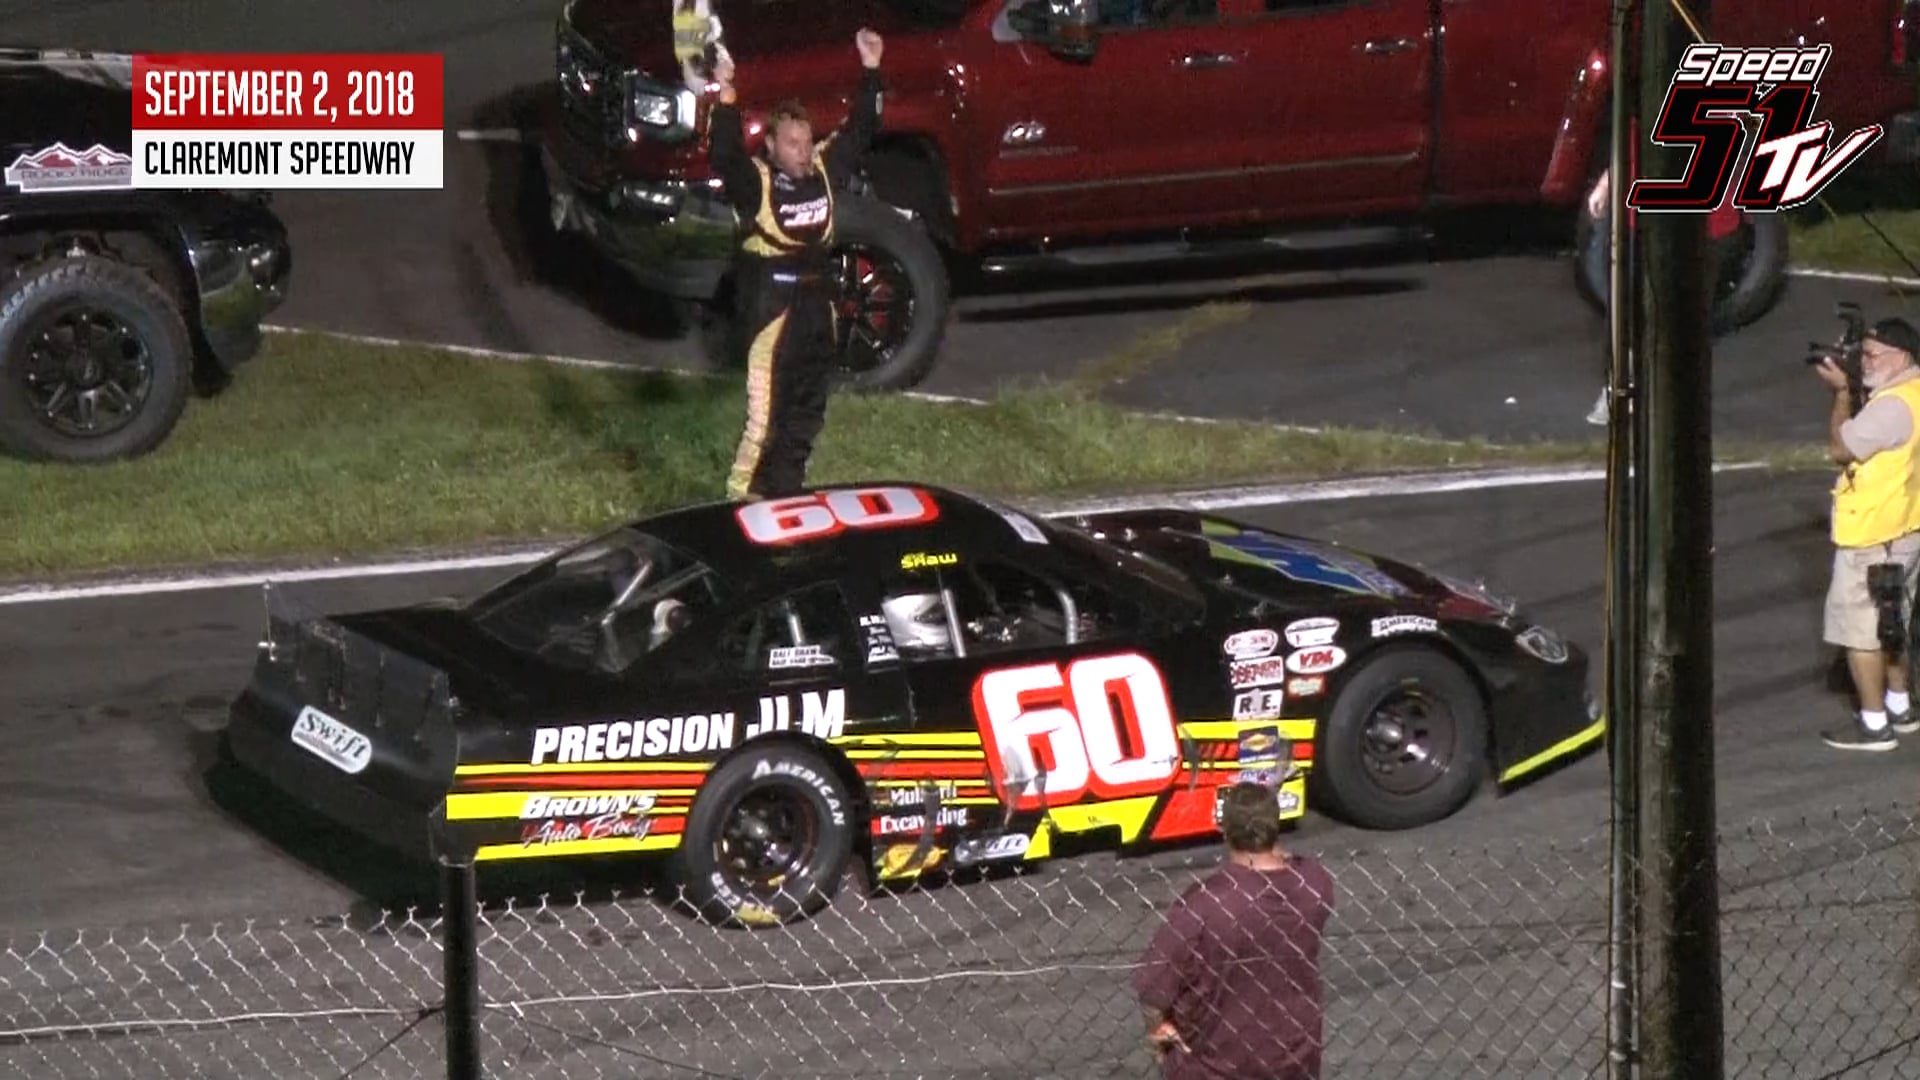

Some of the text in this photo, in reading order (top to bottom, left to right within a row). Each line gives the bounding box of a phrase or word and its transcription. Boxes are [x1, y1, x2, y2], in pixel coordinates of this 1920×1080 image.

[735, 485, 939, 546] 60
[300, 713, 367, 759] Swift
[530, 713, 735, 765] PRECISION
[971, 654, 1182, 811] 60
[519, 792, 657, 819] BROWN'S
[752, 759, 846, 827] AMERICAN
